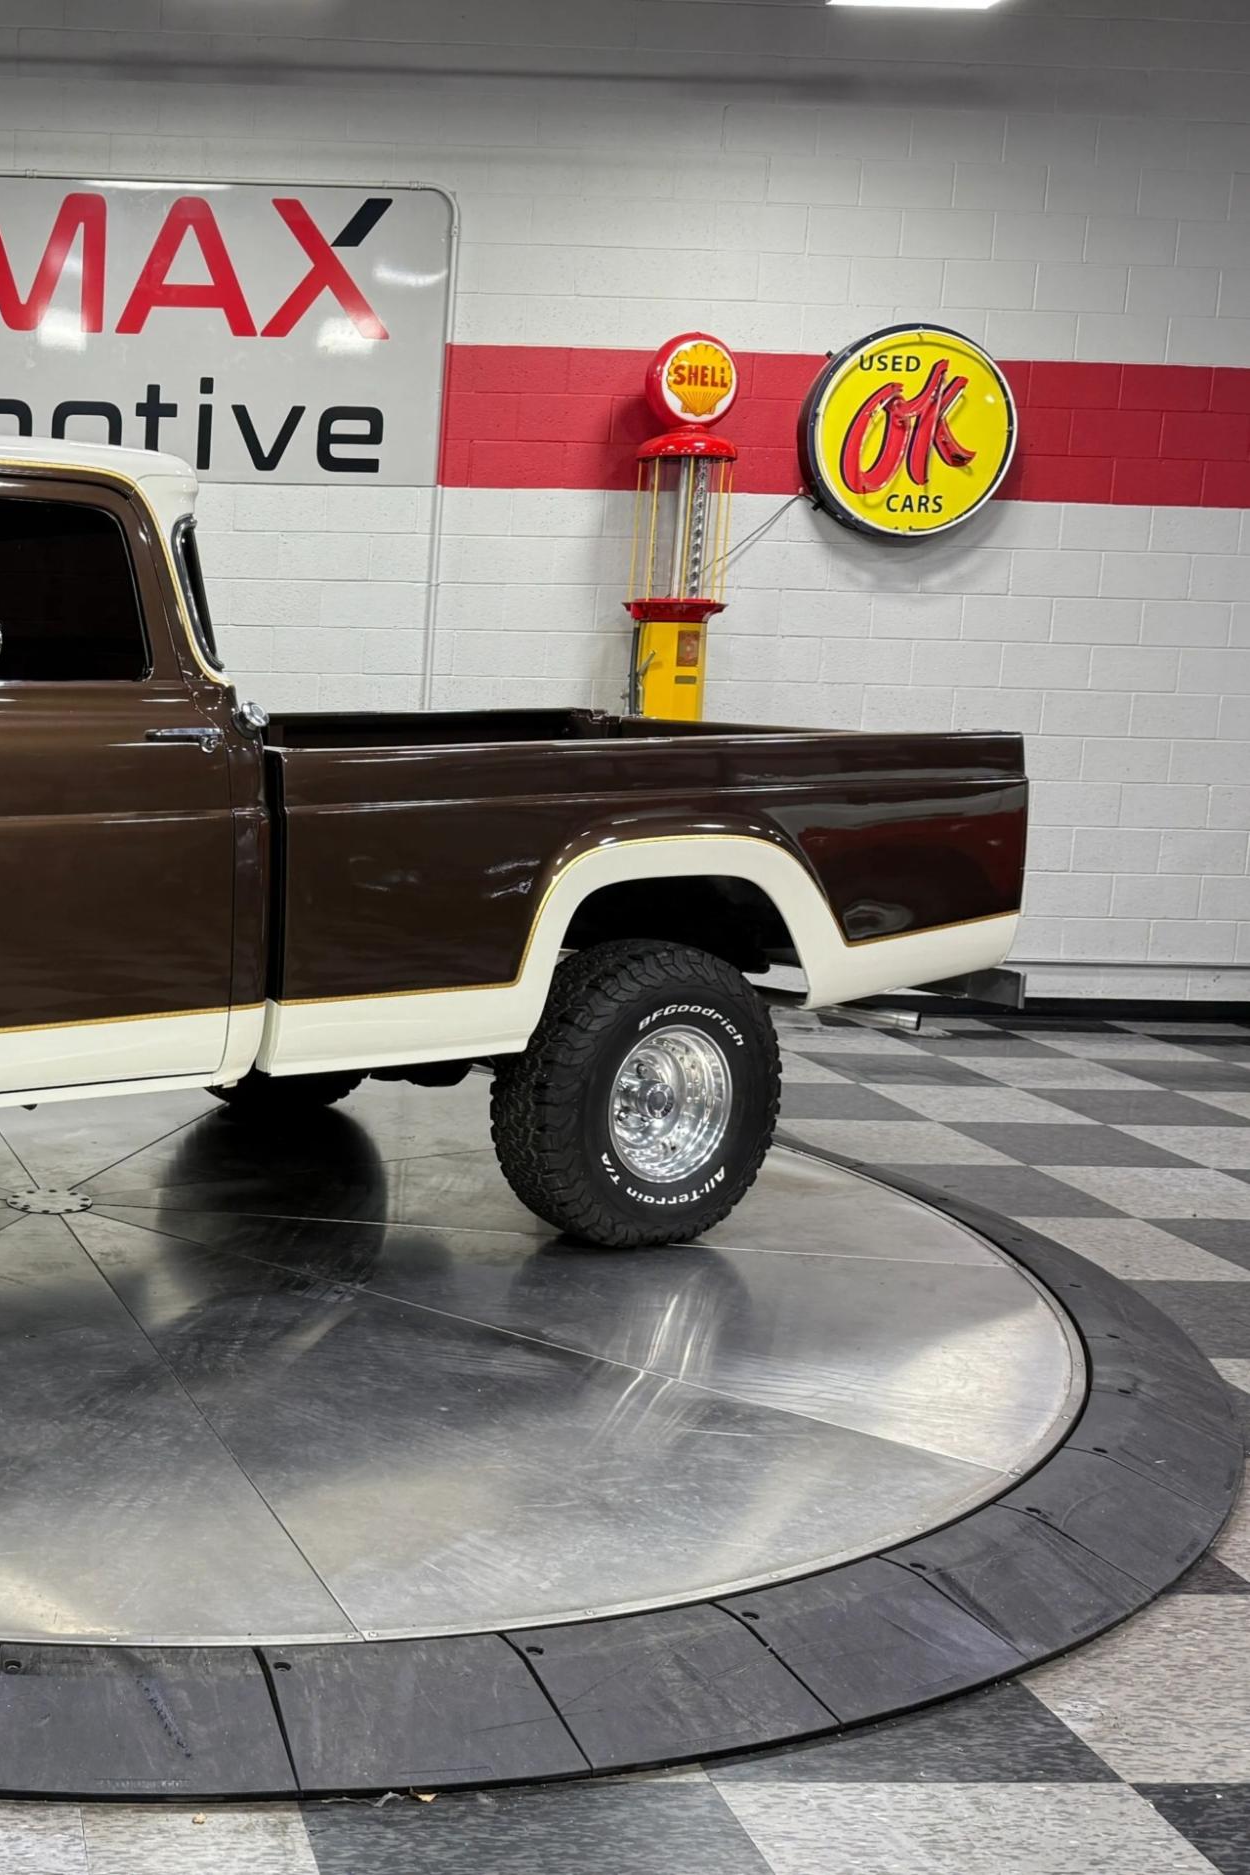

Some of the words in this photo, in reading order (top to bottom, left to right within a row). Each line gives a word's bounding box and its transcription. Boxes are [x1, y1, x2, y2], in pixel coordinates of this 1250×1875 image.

[673, 364, 729, 389] SHELL
[859, 354, 921, 373] USED
[840, 359, 976, 495] OK
[886, 494, 943, 514] CARS
[638, 1004, 744, 1046] BFGoodrich
[601, 1152, 620, 1185] T/A
[626, 1165, 726, 1205] All-Terrain
